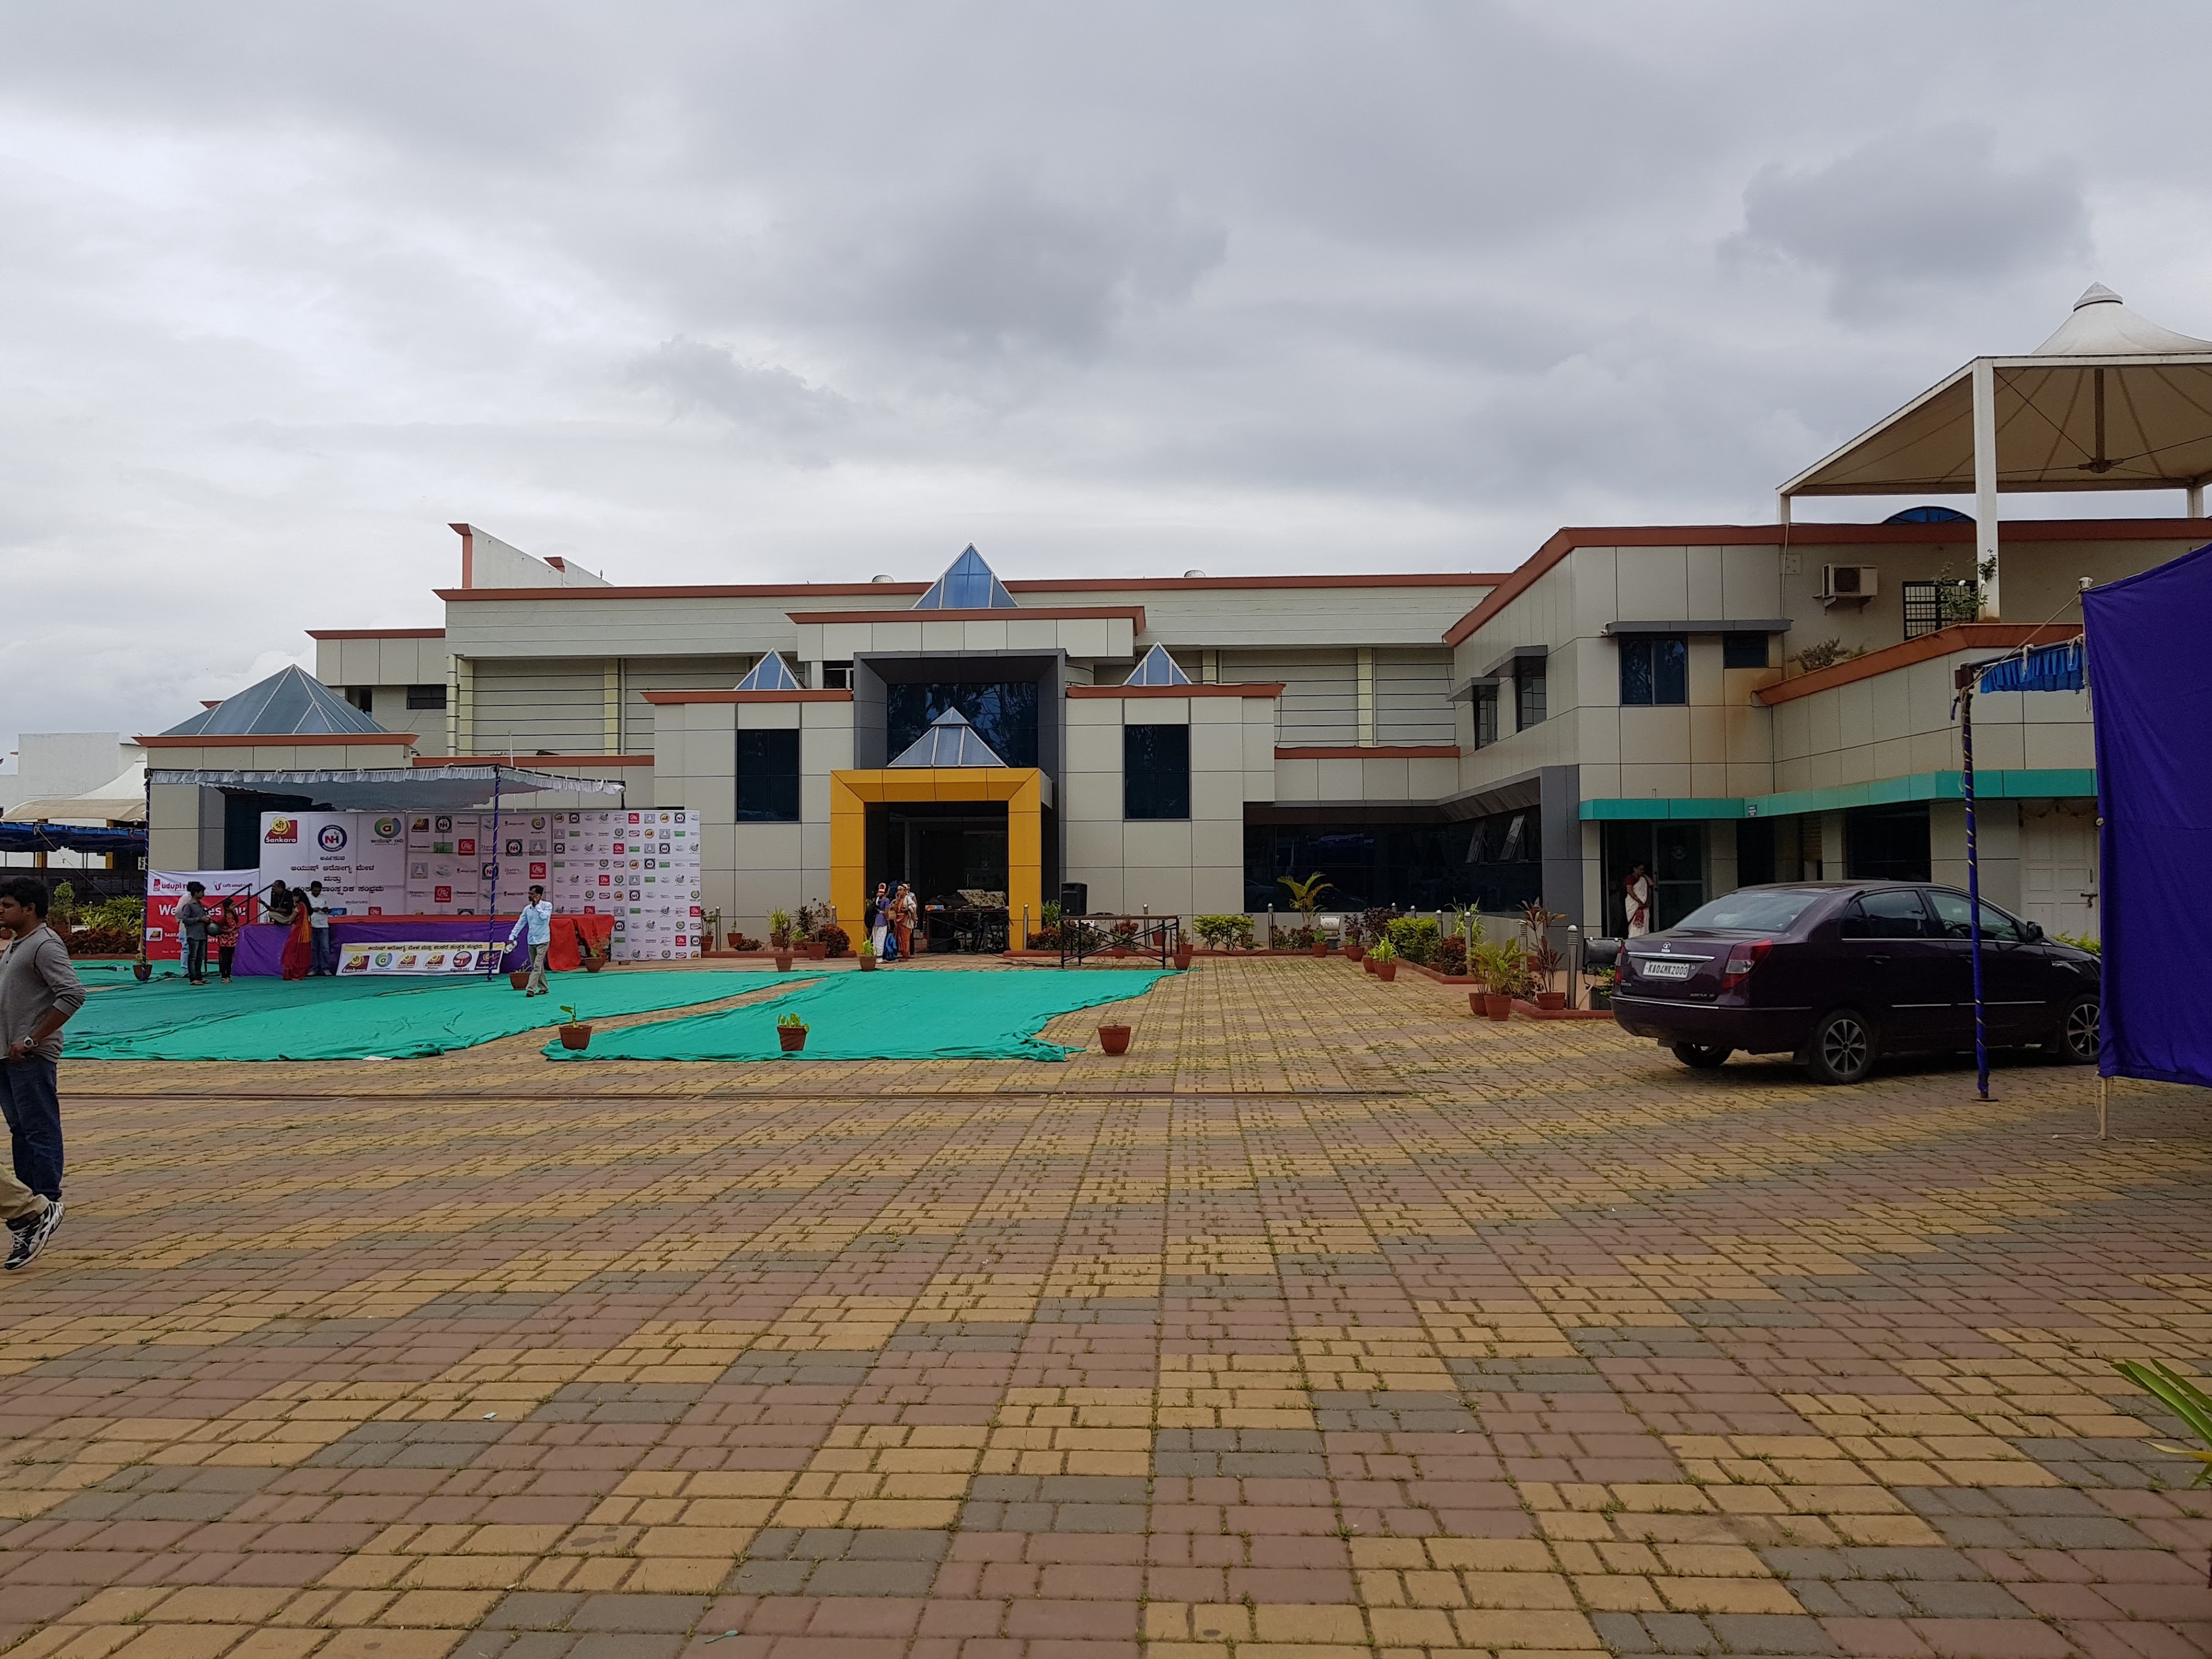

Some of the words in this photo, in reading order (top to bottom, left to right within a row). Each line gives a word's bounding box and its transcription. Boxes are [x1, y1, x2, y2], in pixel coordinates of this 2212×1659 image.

[275, 821, 285, 830] श्री
[325, 835, 339, 843] NH
[162, 882, 181, 891] udupi
